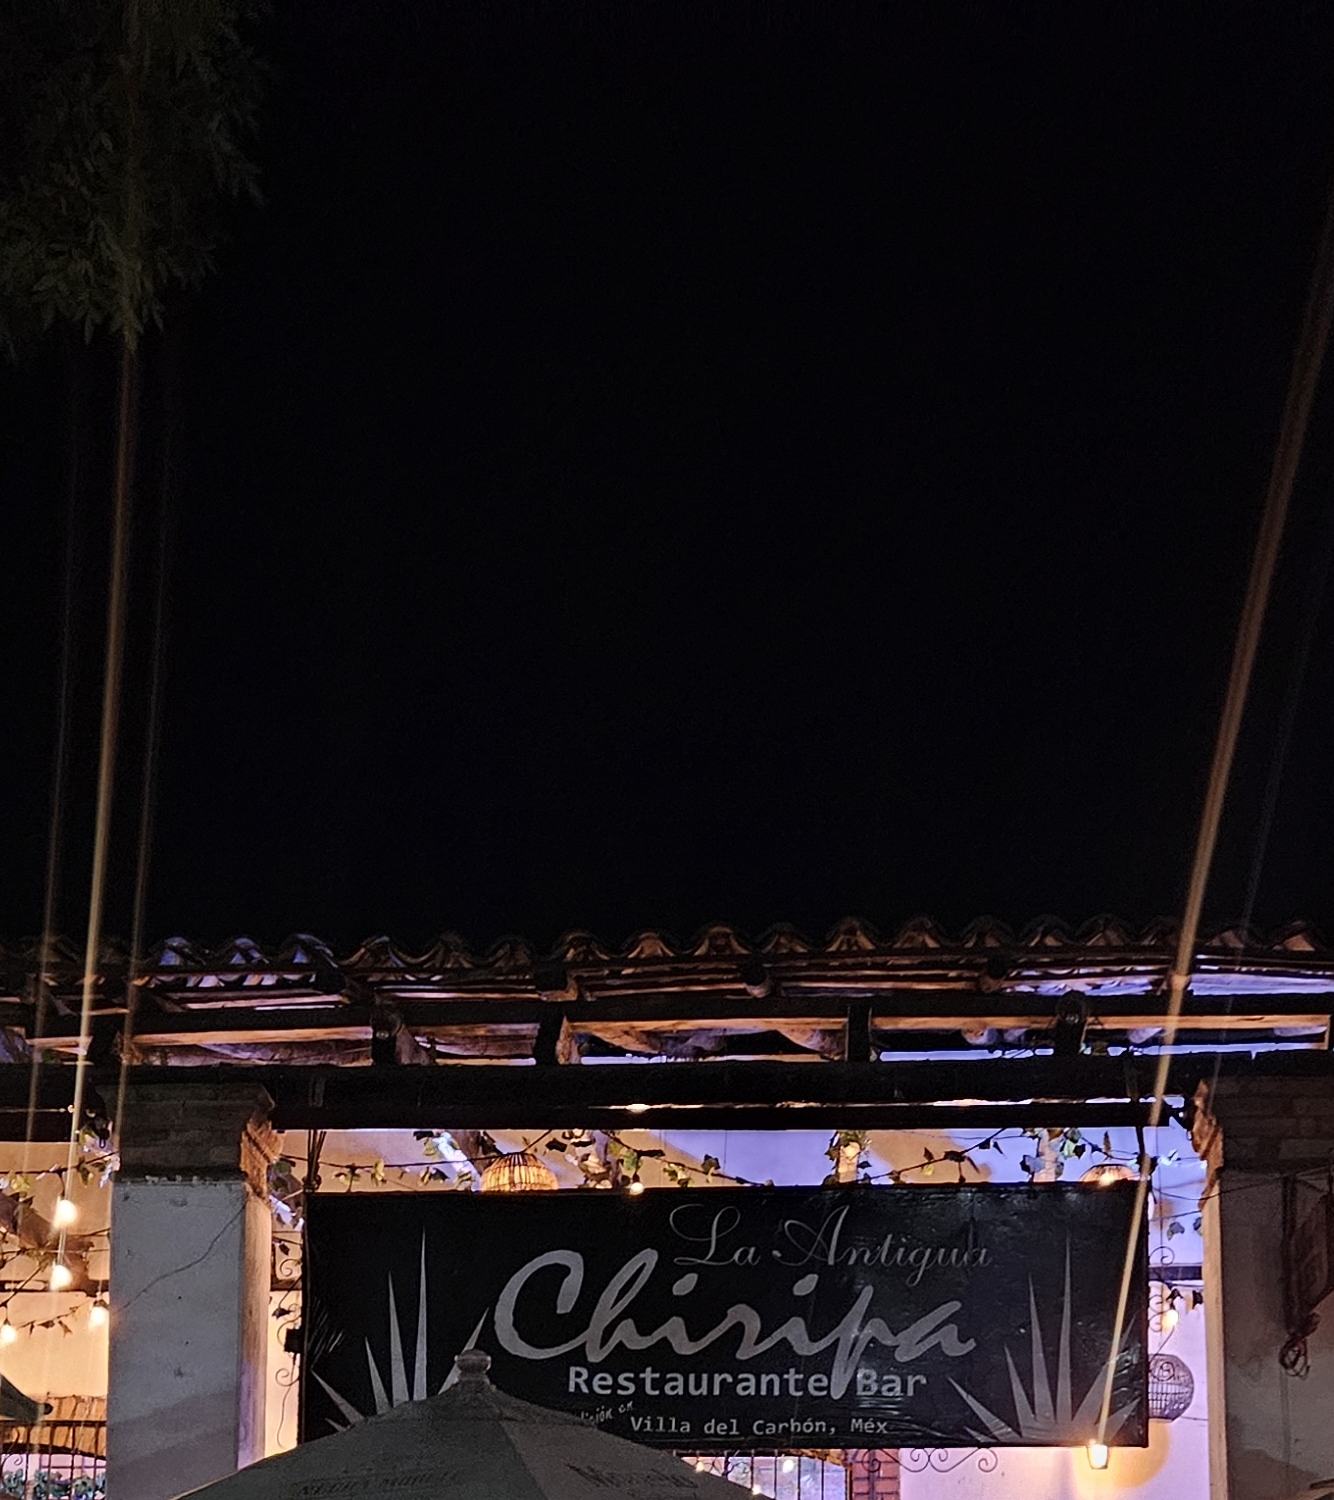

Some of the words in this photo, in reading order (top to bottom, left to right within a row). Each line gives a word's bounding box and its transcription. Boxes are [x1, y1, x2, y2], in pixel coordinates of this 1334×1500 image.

[669, 1202, 761, 1266] La
[772, 1204, 993, 1287] Antigua
[494, 1248, 977, 1401] Chiripa
[567, 1365, 830, 1399] Restaurante
[855, 1368, 928, 1399] Bar
[630, 1416, 692, 1434] Villa
[703, 1418, 741, 1436] del
